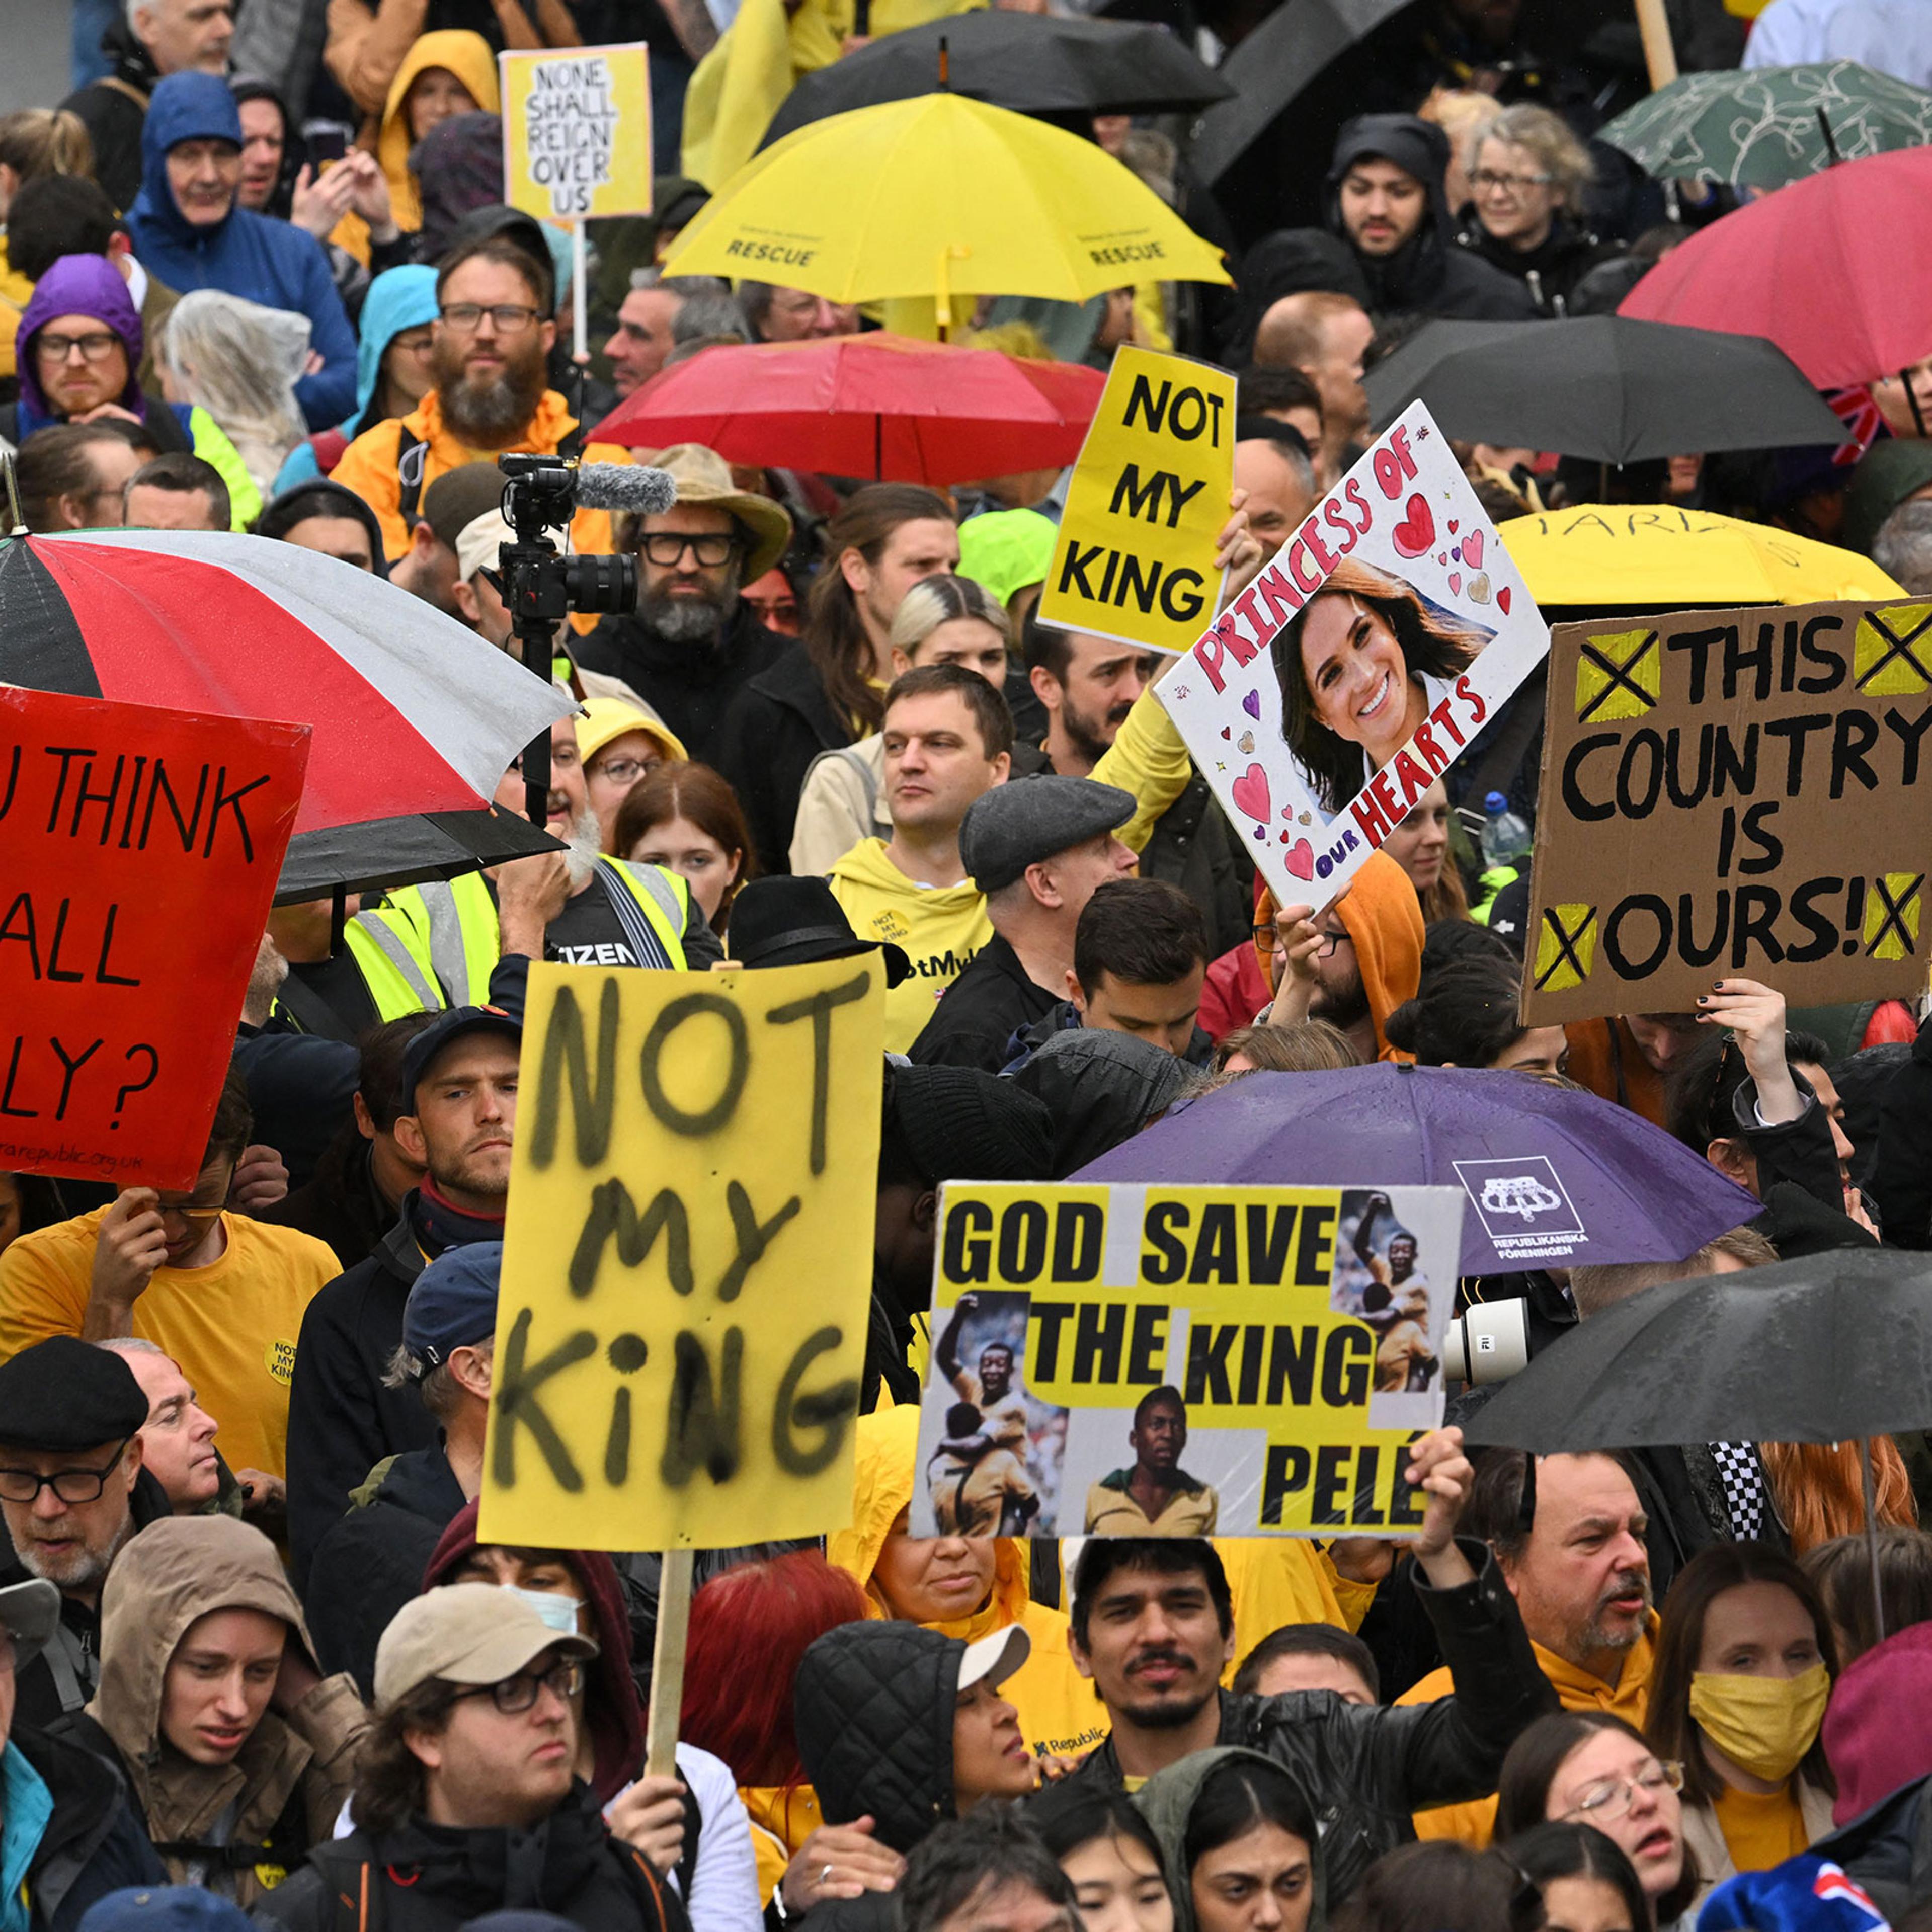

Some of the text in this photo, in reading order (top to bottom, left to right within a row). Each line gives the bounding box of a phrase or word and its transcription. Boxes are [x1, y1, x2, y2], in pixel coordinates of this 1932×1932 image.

[537, 59, 605, 90] NONE
[527, 91, 618, 121] SHALL
[528, 122, 609, 151] REIGN
[533, 151, 610, 185] OVER
[554, 186, 589, 213] US
[727, 238, 816, 267] RESCUE
[1089, 240, 1166, 267] RESCUE
[1122, 375, 1224, 447] NOT
[1109, 464, 1206, 528] MY
[1058, 540, 1204, 622] KING
[1193, 424, 1418, 694] PRINCESS OF
[1667, 615, 1847, 705] THIS
[1315, 675, 1486, 879] OUR HEARTS
[1562, 706, 1931, 822] COUNTRY
[45, 747, 270, 864] THINK
[1717, 800, 1784, 878] IS
[0, 893, 141, 987] ALL
[872, 912, 894, 927] NOT
[881, 923, 896, 933] MY
[883, 929, 908, 942] KING
[1603, 875, 1865, 981] OURS!
[528, 969, 871, 1178] NOT
[568, 1176, 802, 1304] MY
[943, 1200, 1336, 1286] GOD SAVE
[1492, 1234, 1589, 1248] REPUBLIKANSKA
[1497, 1245, 1574, 1259] FÖRENINGEN
[271, 1363, 291, 1378] KIN
[275, 1342, 297, 1357] NOT
[277, 1354, 294, 1367] MY
[1030, 1302, 1372, 1408] THE KING
[1261, 1430, 1433, 1525] PELÉ
[1050, 1727, 1105, 1752] Republic
